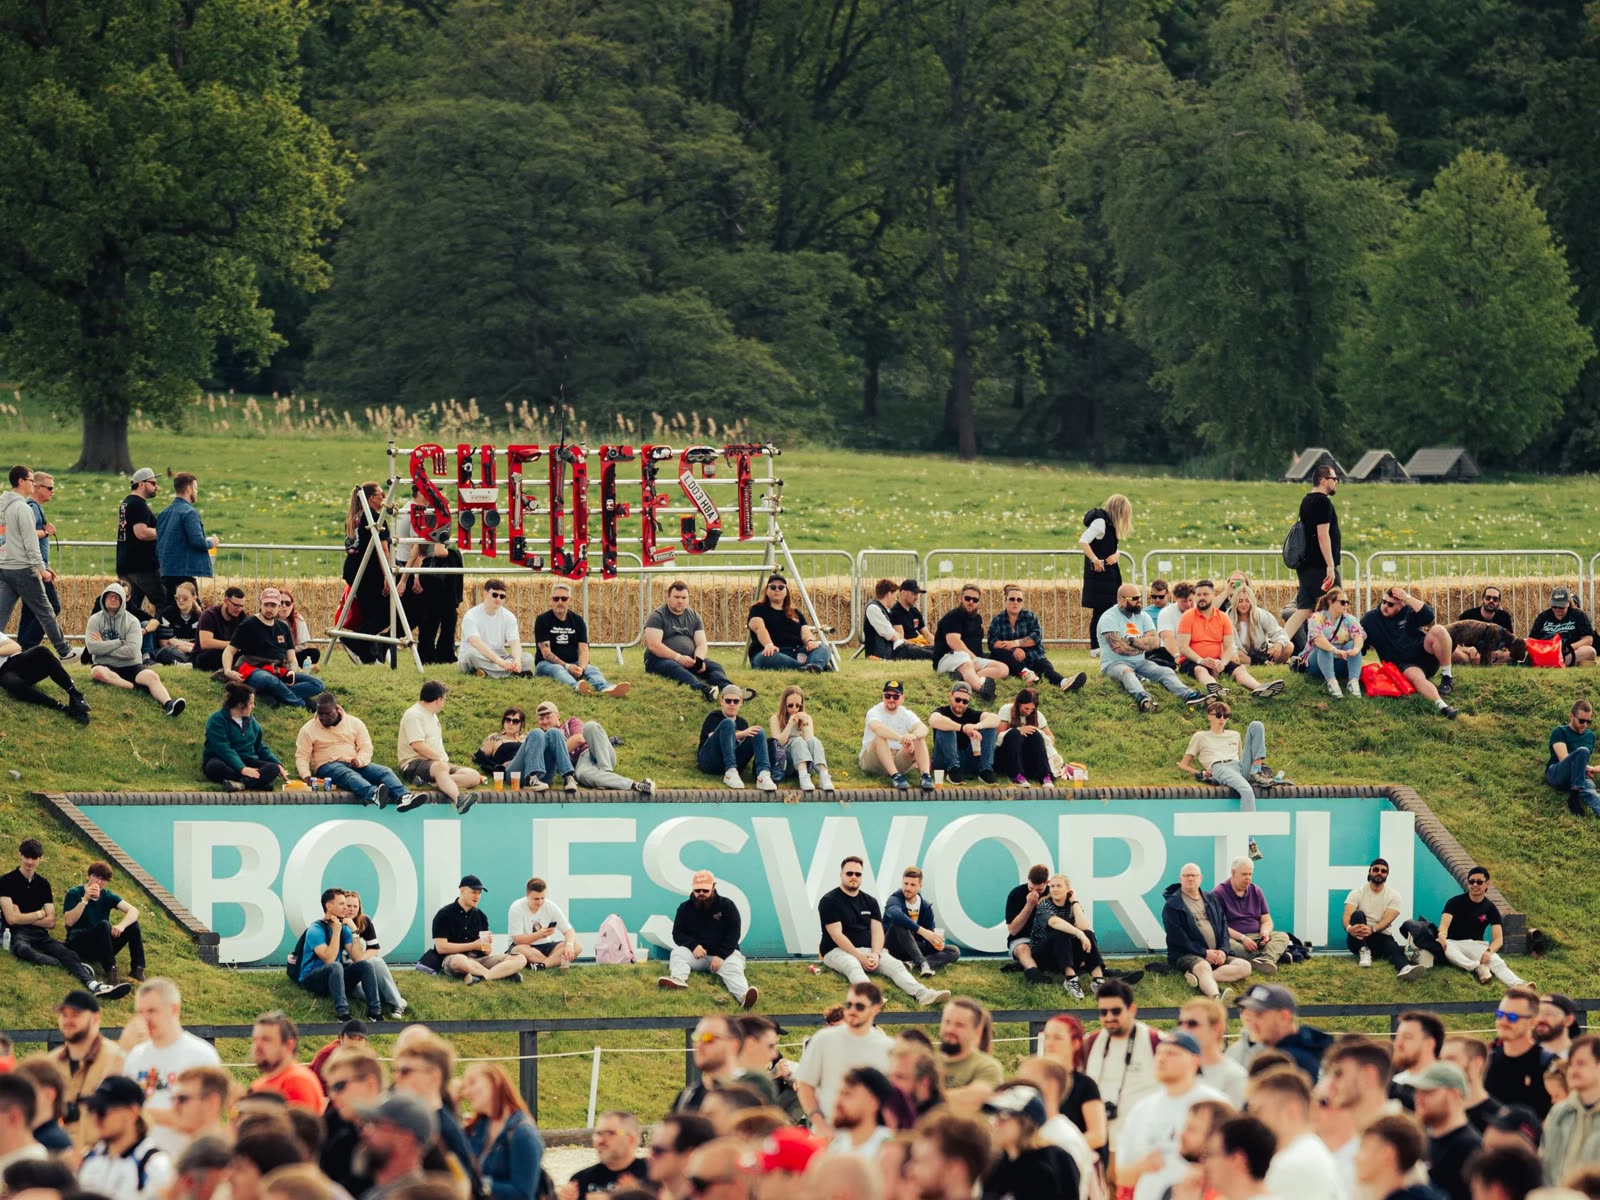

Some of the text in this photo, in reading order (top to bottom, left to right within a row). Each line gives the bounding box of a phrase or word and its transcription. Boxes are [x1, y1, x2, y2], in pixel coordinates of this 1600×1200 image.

[410, 444, 764, 579] SHEDFEST
[700, 499, 715, 520] HBA
[173, 811, 1415, 964] BOLESWORTH
